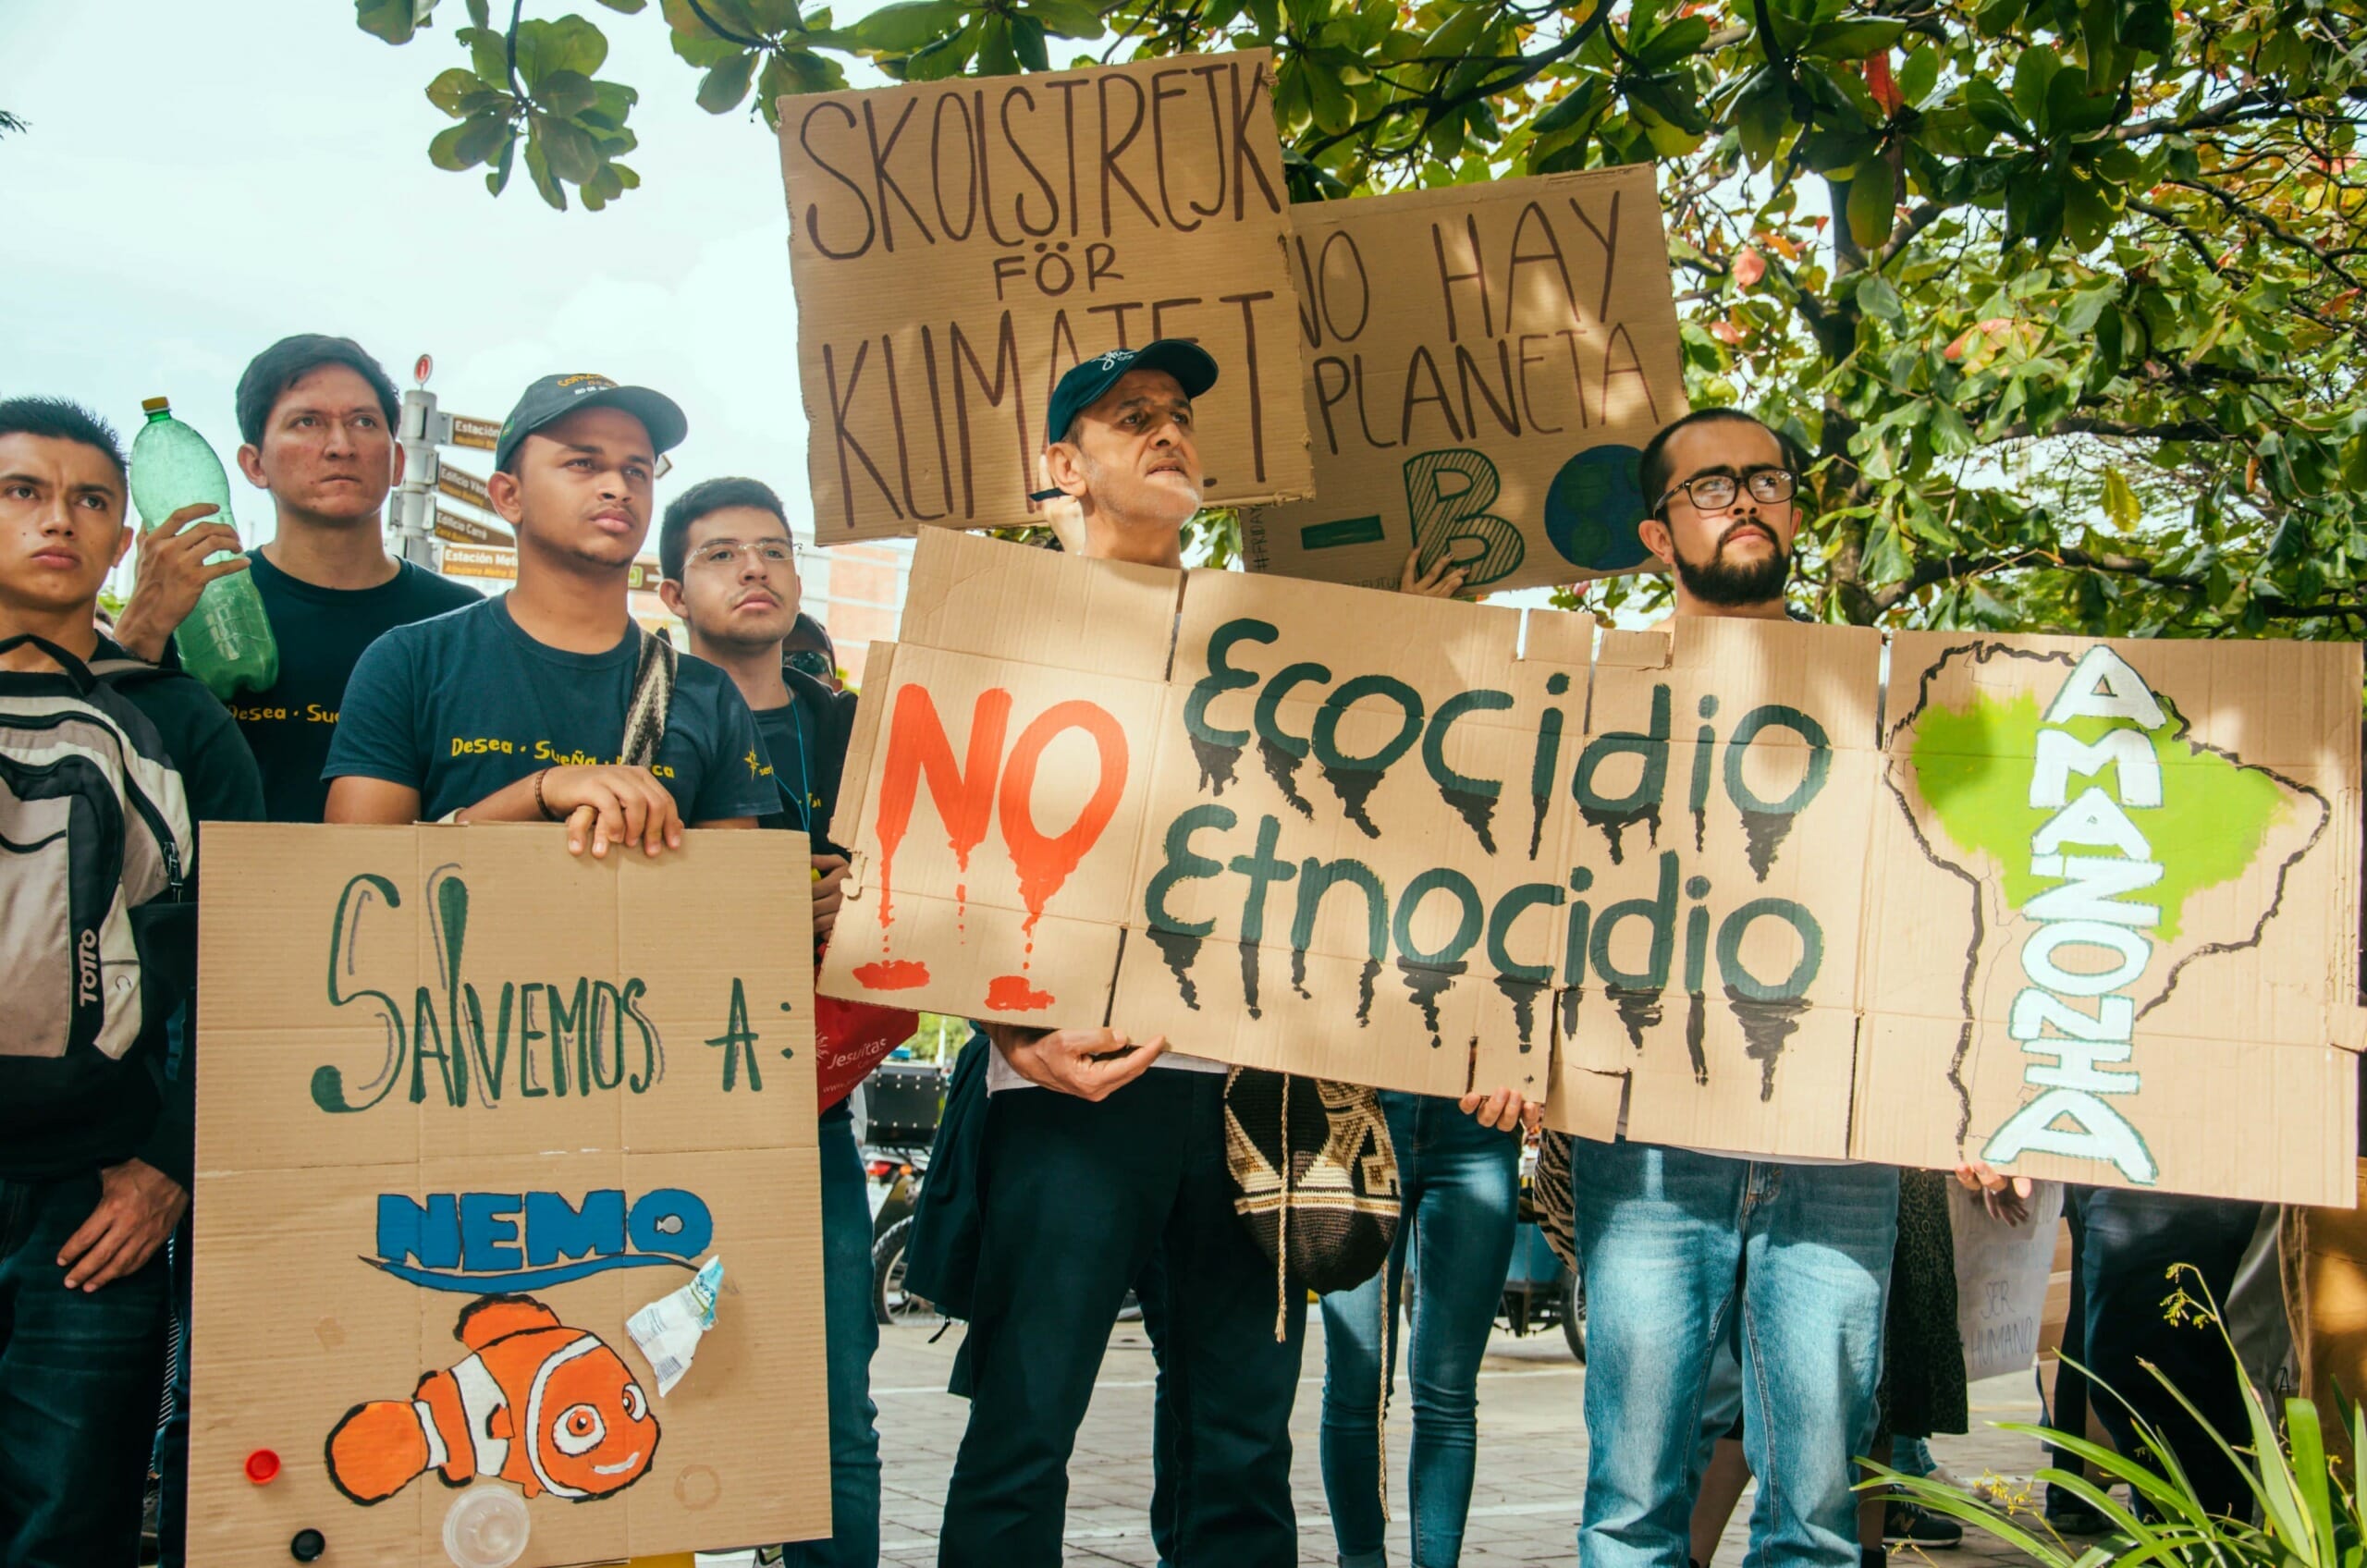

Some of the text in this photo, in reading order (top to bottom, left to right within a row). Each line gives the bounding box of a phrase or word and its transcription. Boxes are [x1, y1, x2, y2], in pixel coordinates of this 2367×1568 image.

[799, 61, 1282, 260] SKOLSTREJK
[992, 242, 1124, 301] FÖR
[1431, 190, 1621, 343] HAY
[454, 420, 500, 437] Estación
[1312, 322, 1661, 455] PLANETA
[445, 549, 519, 568] Estación Met
[451, 737, 513, 757] Desea
[1184, 618, 1834, 825] Ecocidio
[876, 682, 1130, 911] NO
[78, 928, 98, 1007] TOTTO
[1145, 802, 1825, 1015] Etnocidio
[1981, 643, 2167, 1187] AMAZONIA
[375, 1188, 714, 1272] NEMO
